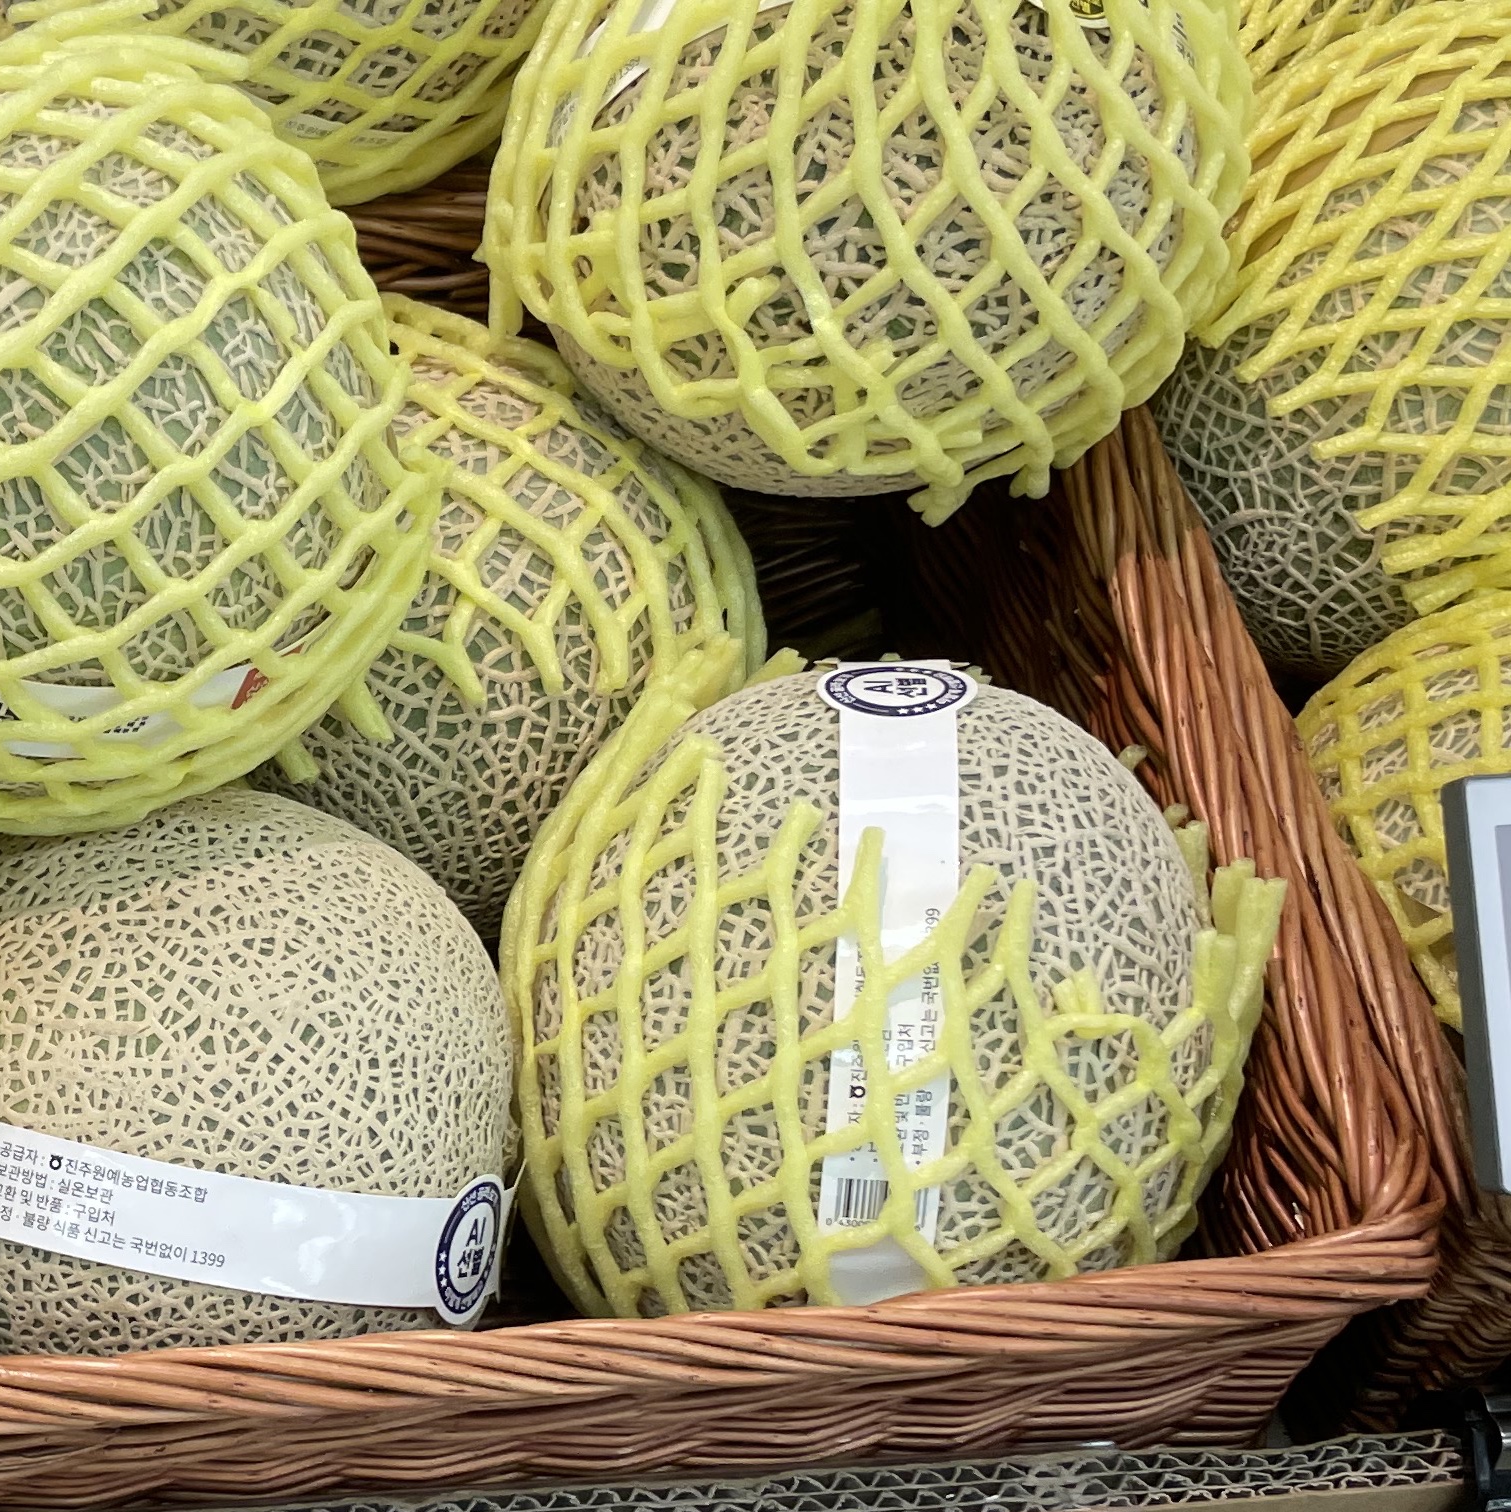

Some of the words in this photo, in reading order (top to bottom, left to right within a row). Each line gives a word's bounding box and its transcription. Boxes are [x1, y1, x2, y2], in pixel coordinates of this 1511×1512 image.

[57, 1178, 114, 1205] 실온보관
[64, 1158, 208, 1204] 진주원예농업협동조합
[19, 1189, 33, 1206] 및
[72, 1203, 116, 1227] 구입처
[53, 1219, 80, 1239] 식품
[83, 1226, 126, 1250] 신고는
[130, 1236, 188, 1263] 국번없이
[189, 1250, 226, 1268] 1399
[465, 1216, 487, 1247] AI
[456, 1246, 485, 1279] 선별
